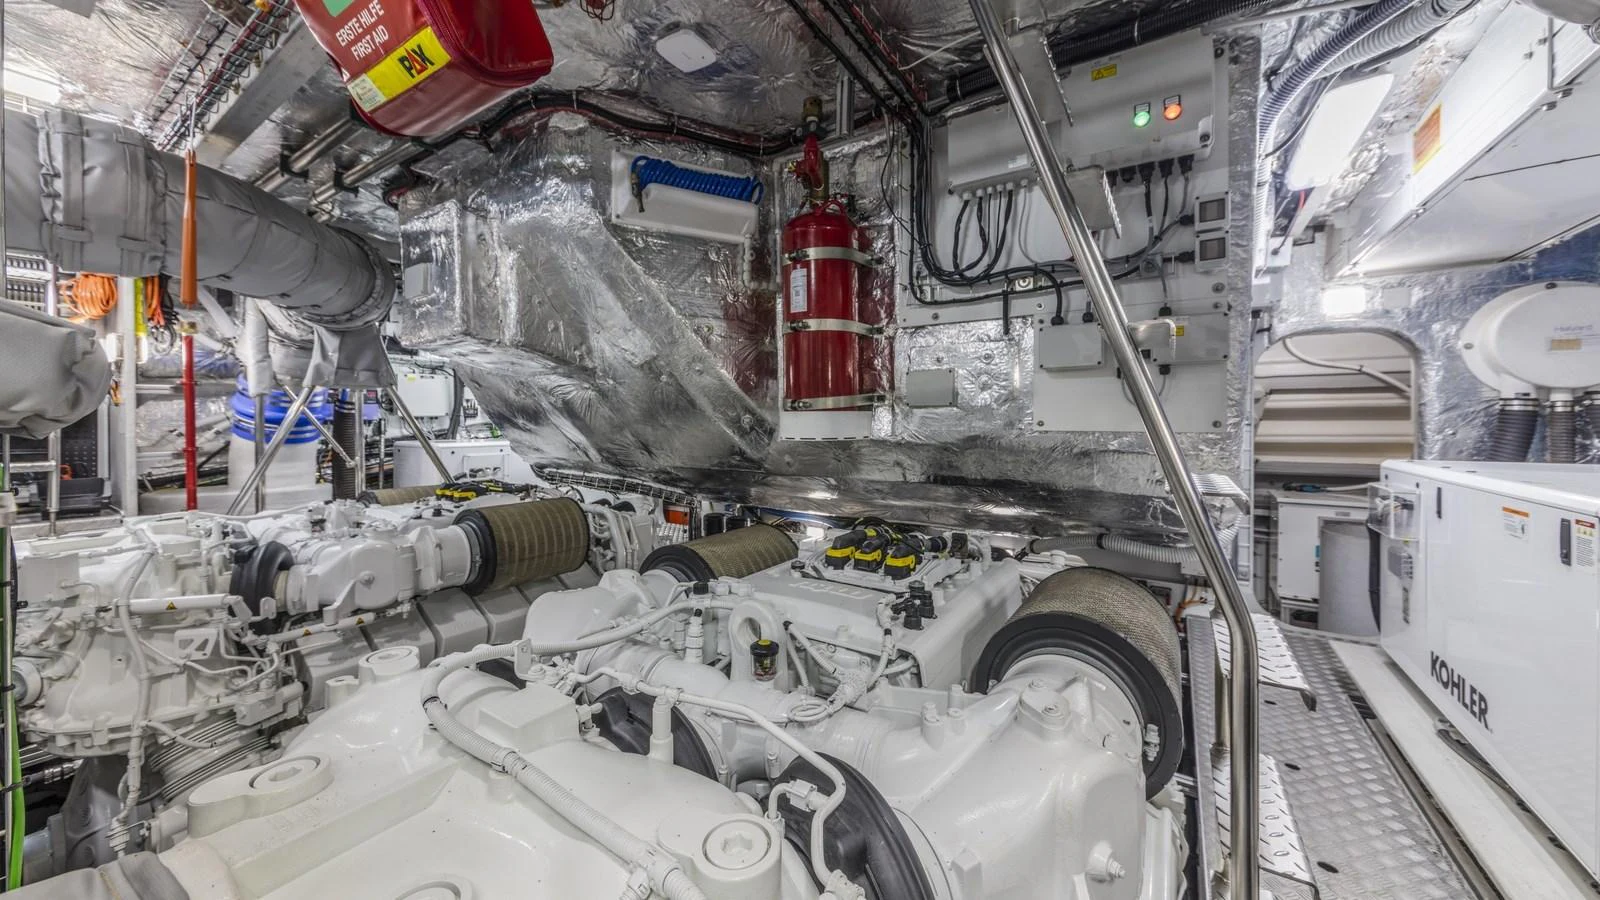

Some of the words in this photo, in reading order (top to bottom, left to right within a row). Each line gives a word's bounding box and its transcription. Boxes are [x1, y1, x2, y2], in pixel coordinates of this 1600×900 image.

[335, 17, 364, 47] ERSTE
[357, 0, 384, 29] HILFE
[351, 35, 376, 61] FIRST
[372, 25, 389, 46] AID
[1430, 650, 1489, 729] KOHLER
